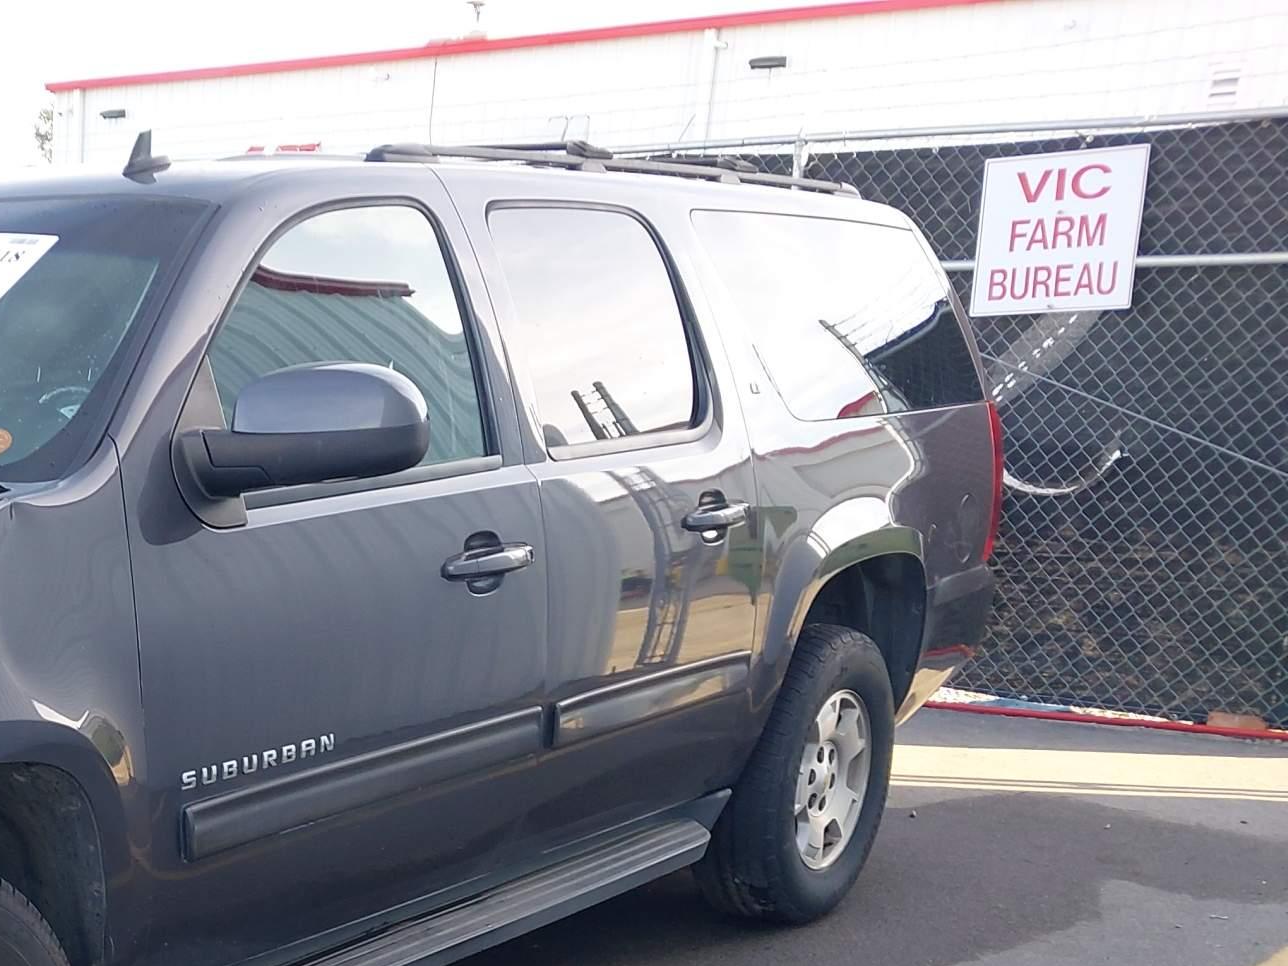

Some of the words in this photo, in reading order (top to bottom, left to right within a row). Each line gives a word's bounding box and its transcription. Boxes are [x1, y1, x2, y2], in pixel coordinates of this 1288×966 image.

[1017, 163, 1113, 203] VIC
[1009, 212, 1108, 252] FARM
[987, 260, 1119, 301] BUREAU
[181, 733, 335, 790] SUBURBAN
